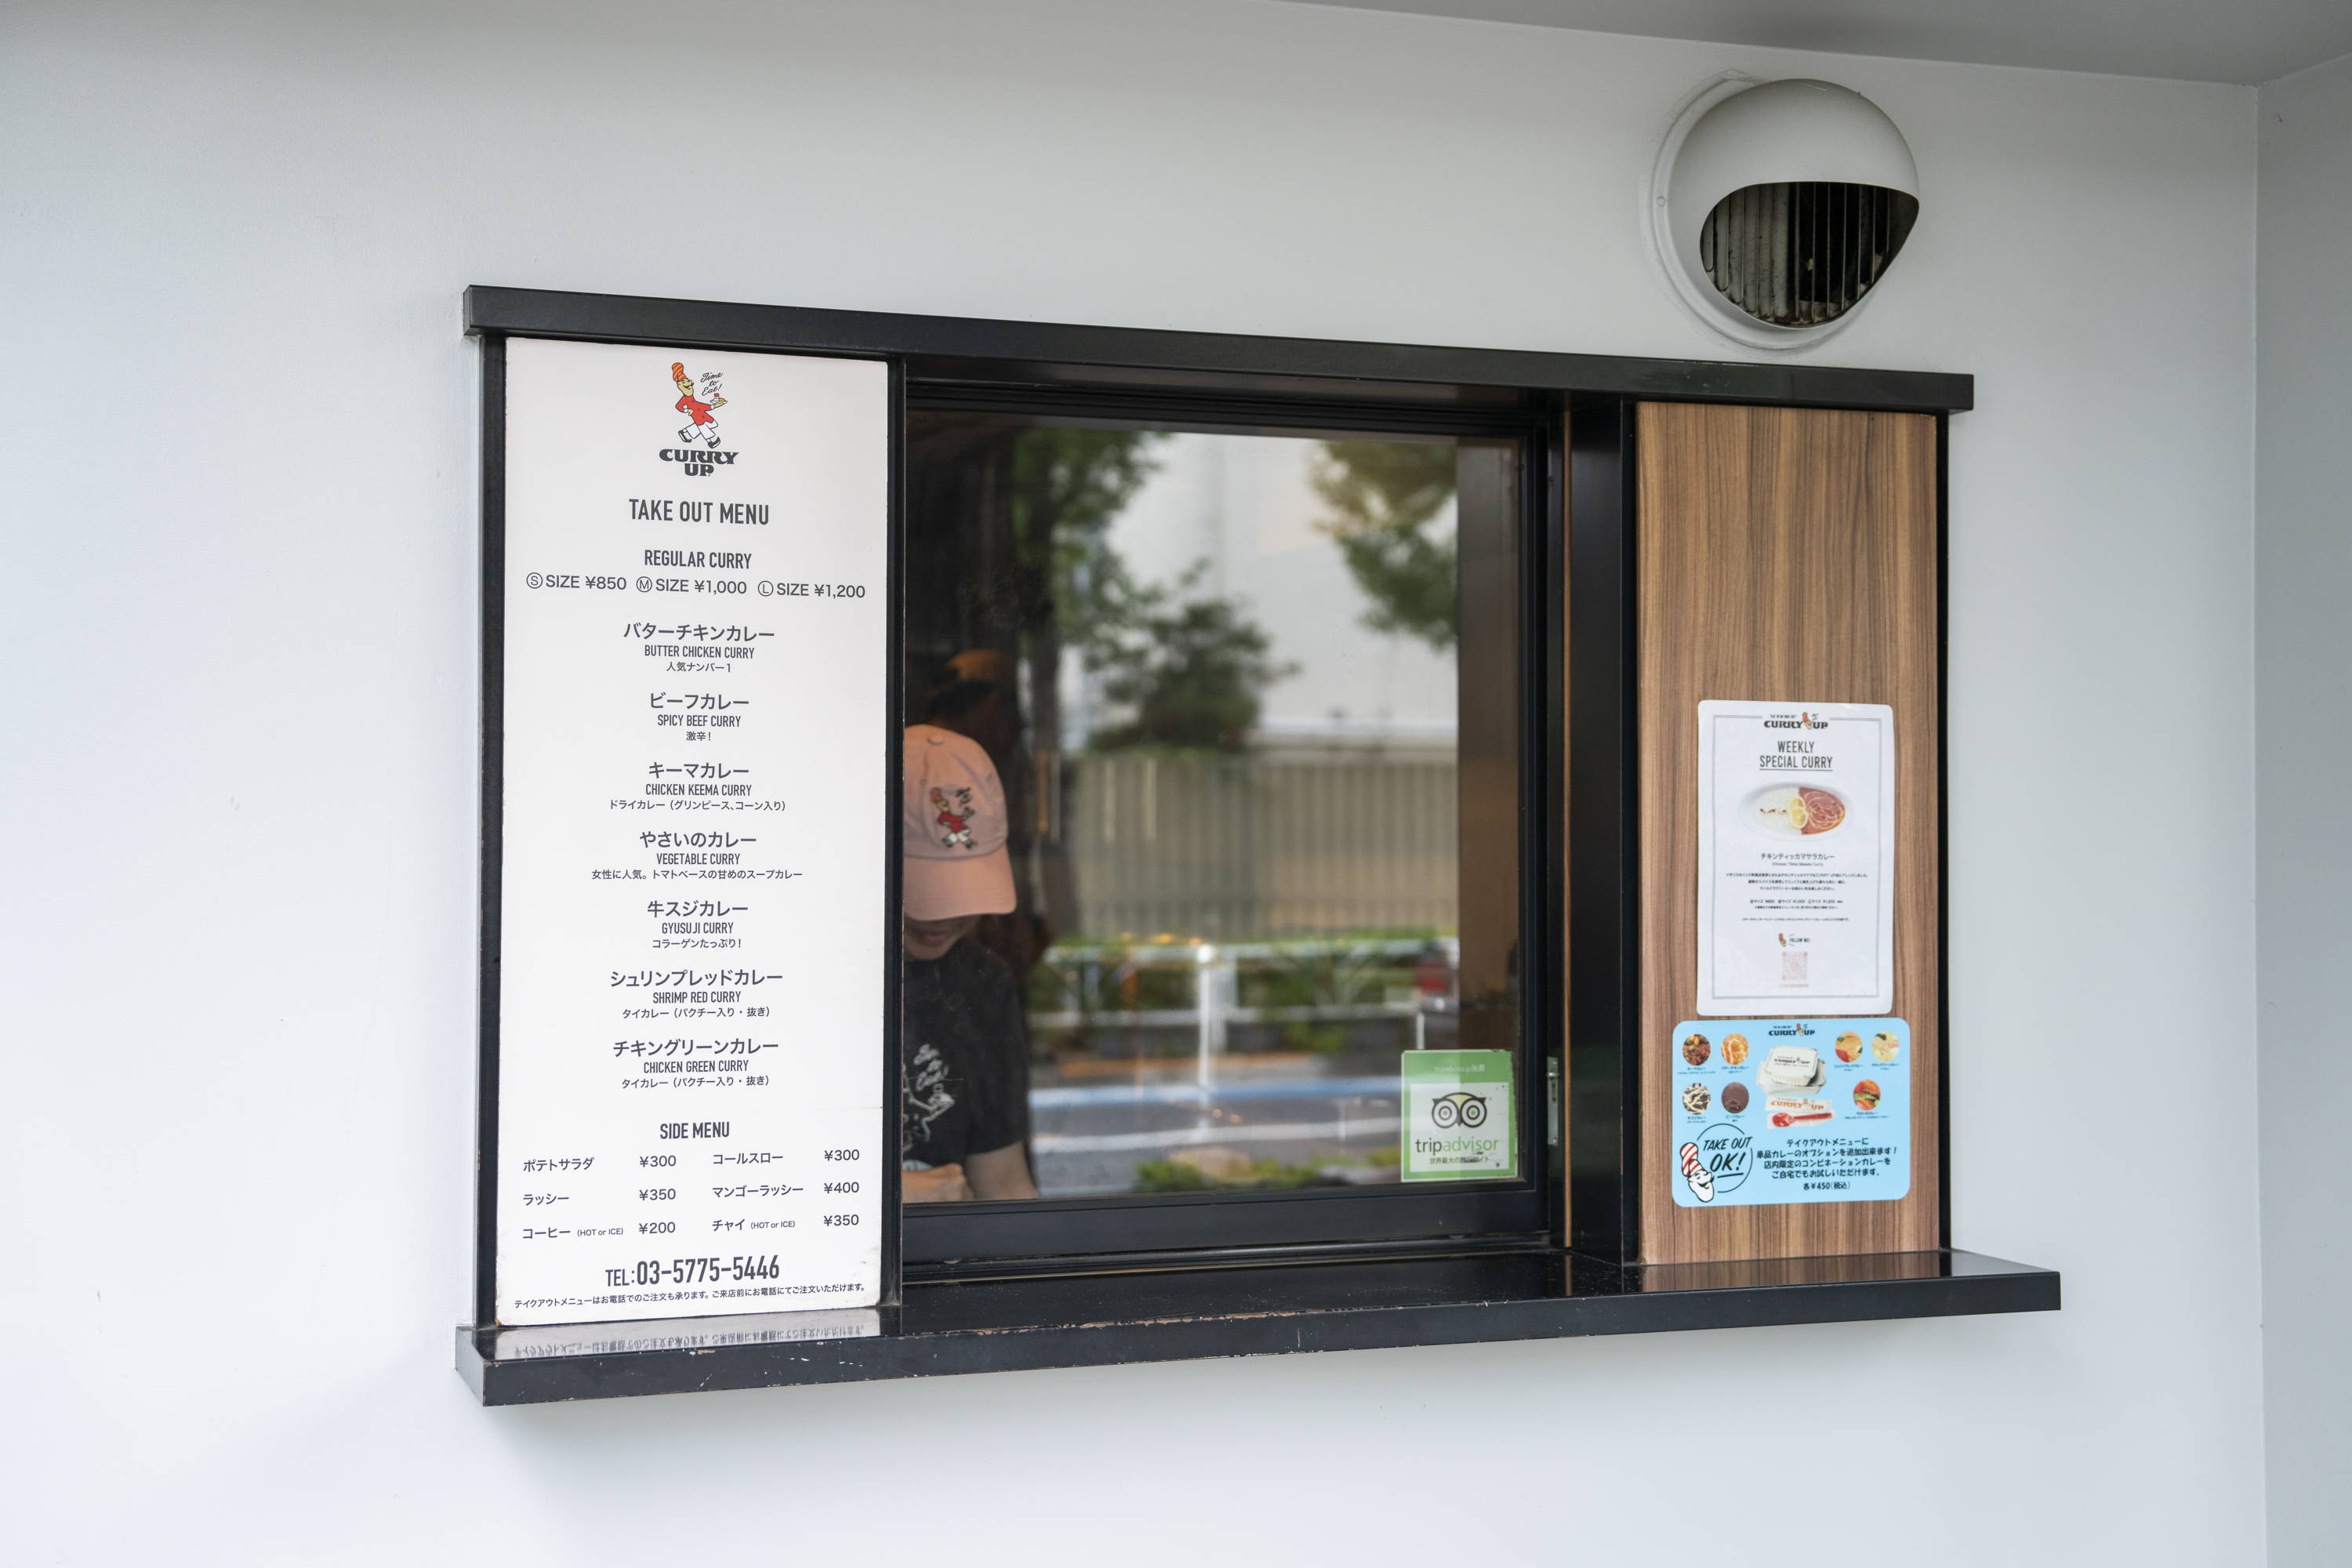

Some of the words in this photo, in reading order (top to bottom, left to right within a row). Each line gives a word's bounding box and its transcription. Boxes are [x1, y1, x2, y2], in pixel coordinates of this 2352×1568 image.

[700, 372, 723, 383] Time
[702, 383, 722, 396] Eat!
[659, 449, 739, 465] CURRY
[684, 464, 714, 476] UP
[629, 499, 673, 521] TAKE
[680, 501, 713, 522] OUT
[720, 503, 768, 524] MENU
[645, 550, 705, 568] REGULAR
[710, 552, 752, 569] CURRY
[586, 576, 626, 590] ¥850
[695, 580, 746, 595] ¥1,000
[815, 584, 865, 599] ¥1,200
[624, 622, 775, 641] バターチキンカレー
[645, 645, 679, 657] BUTTER
[683, 646, 720, 658] CHICKEN
[724, 647, 754, 659] CURRY
[666, 662, 730, 672] 人気ナンバー1
[651, 691, 749, 710] ビーフカレー
[658, 714, 684, 726] SPICY
[687, 715, 708, 726] BEEF
[711, 716, 741, 727] CURRY
[687, 731, 710, 741] 激辛!
[1778, 741, 1814, 753] WEEKLY
[1760, 756, 1798, 768] SPECIAL
[1802, 757, 1833, 768] CURRY
[649, 762, 749, 779] キーマカレー
[646, 784, 684, 795] CHICKEN
[688, 784, 719, 796] KEEMA
[722, 785, 752, 796] CURRY
[640, 831, 756, 848] やさいのカレー
[657, 853, 707, 865] VEGETABLE
[710, 853, 740, 865] CURRY
[648, 900, 748, 918] 牛スジカレー
[662, 923, 700, 934] GYUSUJI
[703, 922, 733, 934] CURRY
[653, 938, 740, 948] コラーゲンたっぷり!
[612, 969, 782, 986] シュリンプレッドカレー
[653, 992, 688, 1004] SHRIMP
[691, 992, 707, 1003] RED
[711, 991, 741, 1003] CURRY
[613, 1038, 779, 1057] チキングリーンカレー
[644, 1062, 682, 1073] CHICKEN
[686, 1061, 715, 1073] GREEN
[719, 1060, 749, 1072] CURRY
[660, 1123, 688, 1139] SIDE
[693, 1122, 729, 1138] MENU
[1416, 1137, 1499, 1155] tripadvisor
[1703, 1138, 1729, 1151] TAKE
[1731, 1137, 1752, 1149] OUT
[524, 1157, 594, 1172] ポテトサラダ
[640, 1156, 676, 1167] ¥300
[713, 1153, 783, 1164] コールスロー
[825, 1149, 859, 1161] ¥300
[1710, 1152, 1747, 1172] OK!
[1764, 1158, 1890, 1169] 店内限定のコンビネーションカレーを
[1772, 1170, 1880, 1178] ご自宅でもお試しいただけます。
[713, 1185, 803, 1197] マンゴーラッシー
[824, 1181, 859, 1193] ¥400
[524, 1193, 569, 1206] ラッシー
[640, 1189, 676, 1200] ¥350
[523, 1227, 571, 1239] コーヒー
[639, 1222, 675, 1234] ¥200
[713, 1219, 745, 1232] チャイ
[824, 1214, 858, 1226] ¥350
